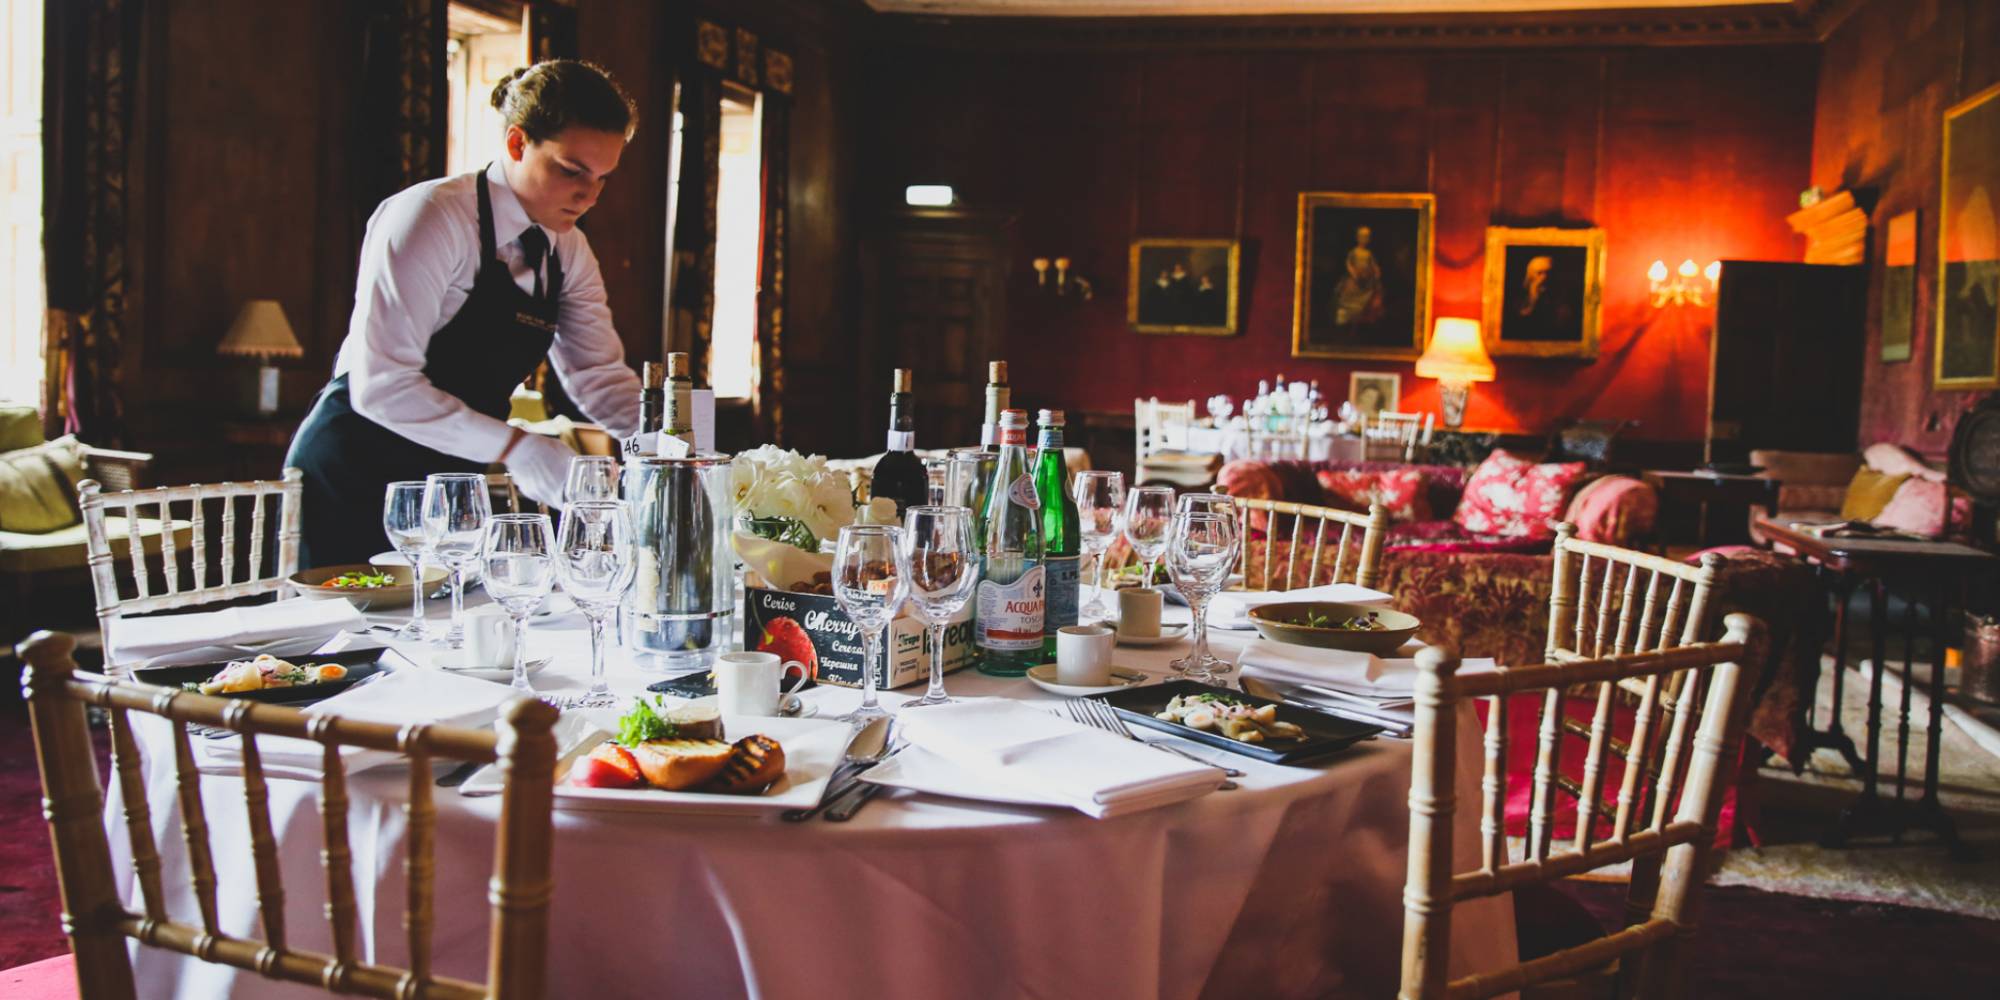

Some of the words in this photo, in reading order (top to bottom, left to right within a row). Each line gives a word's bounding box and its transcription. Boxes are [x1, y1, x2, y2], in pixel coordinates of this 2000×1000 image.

[624, 438, 640, 453] 46
[764, 594, 796, 611] Cerise
[1005, 601, 1039, 615] ACQUA
[804, 610, 862, 641] Cherry
